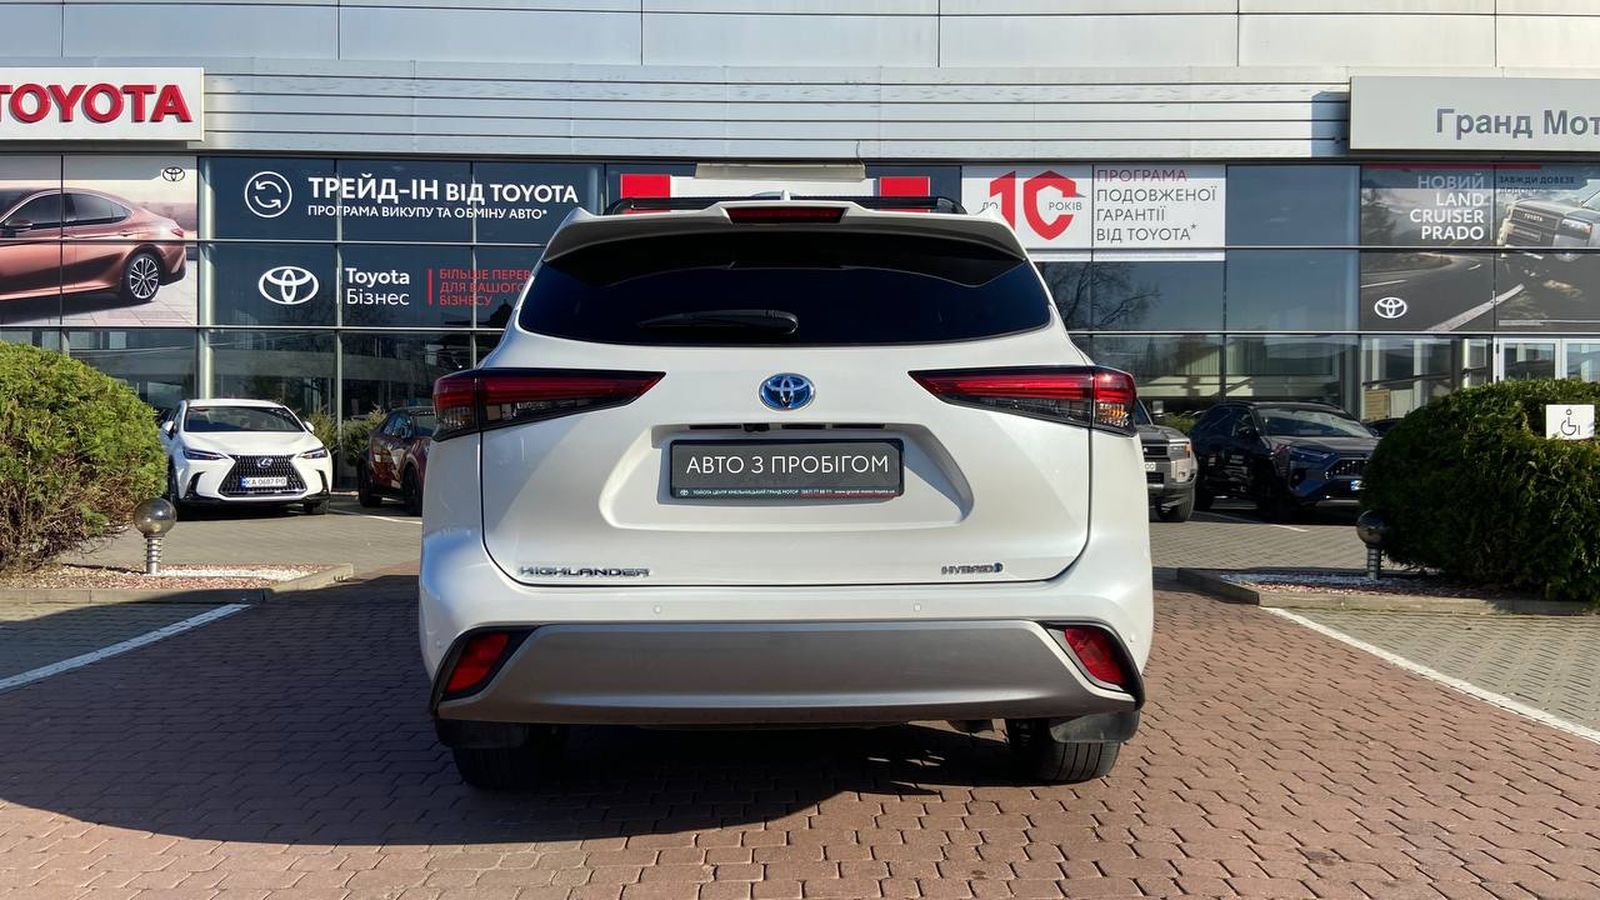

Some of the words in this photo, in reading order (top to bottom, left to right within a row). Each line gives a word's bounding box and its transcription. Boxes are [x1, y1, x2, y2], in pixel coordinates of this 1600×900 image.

[1437, 108, 1533, 140] Гранд
[1097, 169, 1188, 182] ПРОГРАМА
[1418, 173, 1484, 190] НОВИЙ
[446, 184, 485, 204] ВІД
[490, 184, 579, 203] TOYOTA
[1097, 186, 1218, 204] ПОДОВЖЕНОЇ
[1436, 193, 1484, 207] LAND
[308, 205, 379, 217] ПРОГРАМА
[382, 207, 433, 218] ВИКУПУ
[438, 207, 451, 218] ТА
[454, 208, 507, 219] ОБМІНУ
[1048, 202, 1083, 211] РОКІВ
[1097, 206, 1166, 222] ГАРАНТІЇ
[1409, 209, 1485, 224] CRUISER
[1097, 228, 1123, 243] ВІД
[1421, 226, 1484, 241] PRADO
[345, 267, 411, 288] Toyota
[439, 268, 489, 280] БІЛЬШЕ
[439, 282, 467, 294] ДЛЯ
[346, 288, 410, 306] Бізнес
[439, 295, 493, 306] БІЗНЕСУ
[686, 456, 745, 474] АВТО
[751, 456, 764, 474] З
[771, 455, 889, 474] ПРОБІГОМ
[519, 566, 650, 577] HIGHLANDER
